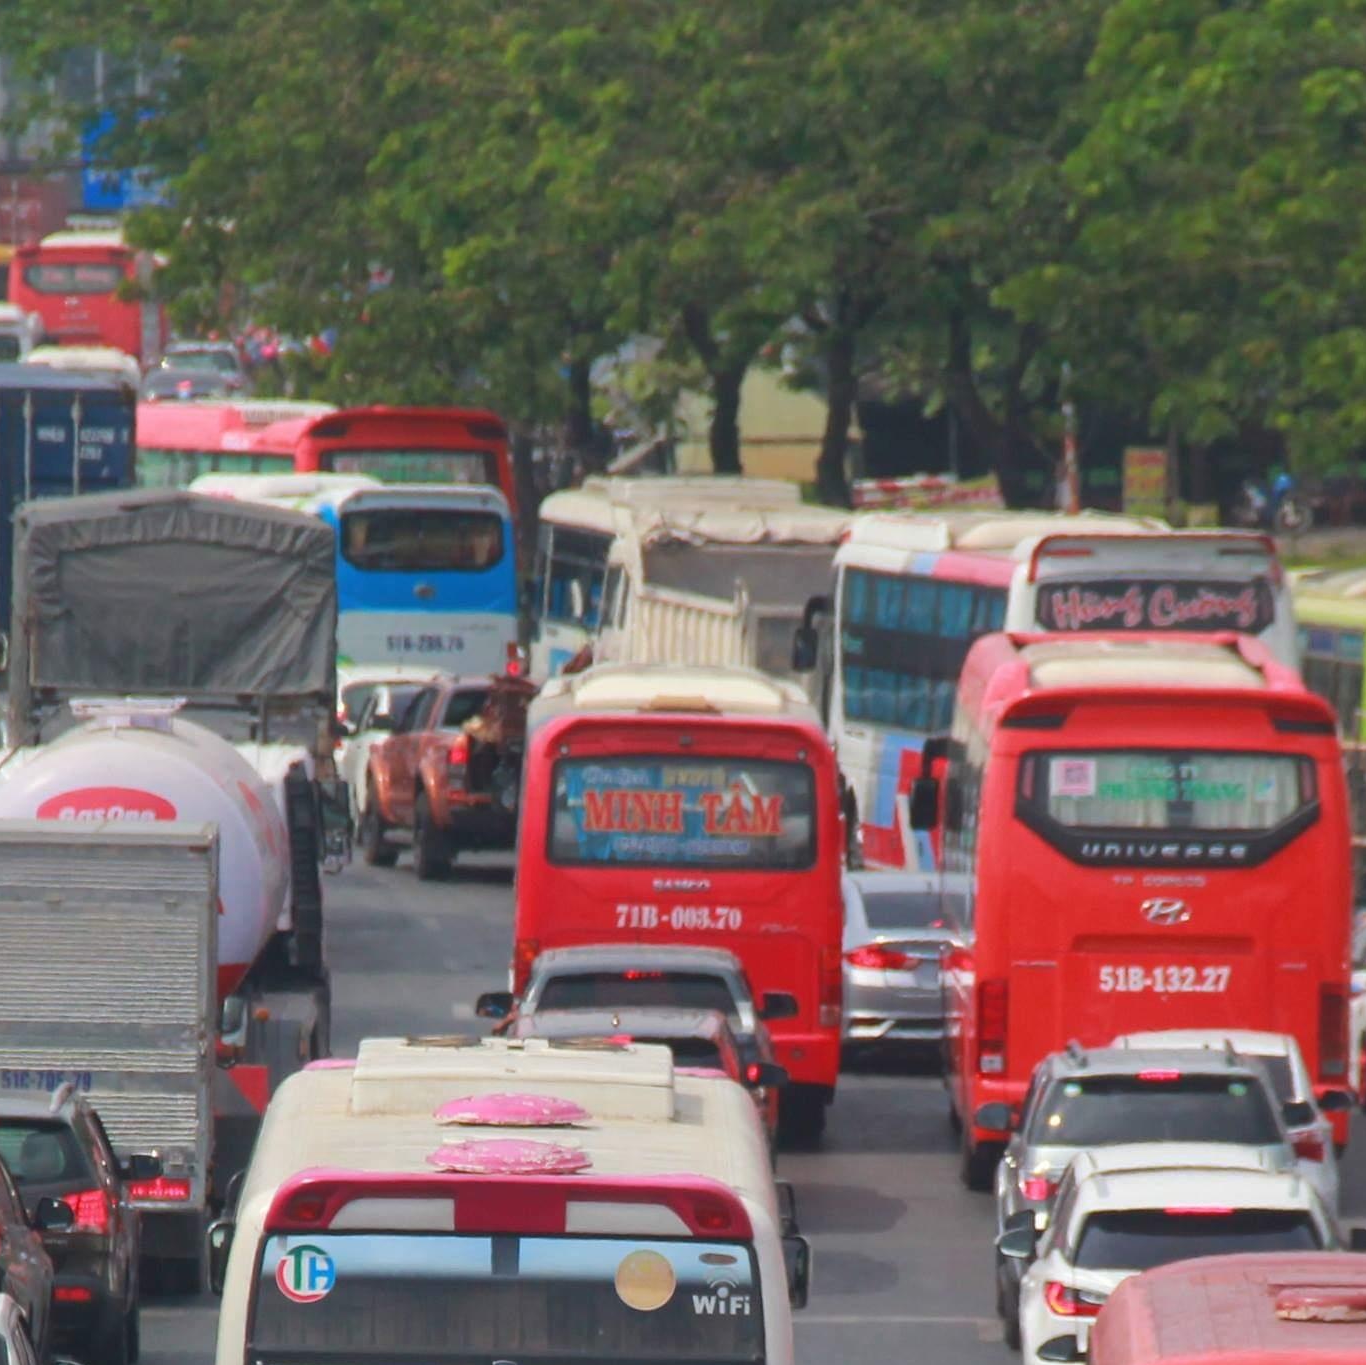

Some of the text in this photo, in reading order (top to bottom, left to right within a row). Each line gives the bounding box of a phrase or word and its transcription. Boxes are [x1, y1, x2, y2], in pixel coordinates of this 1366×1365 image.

[583, 789, 684, 833] MINH
[1098, 965, 1232, 994] 51B-132.27
[692, 1287, 752, 1317] WiFi
